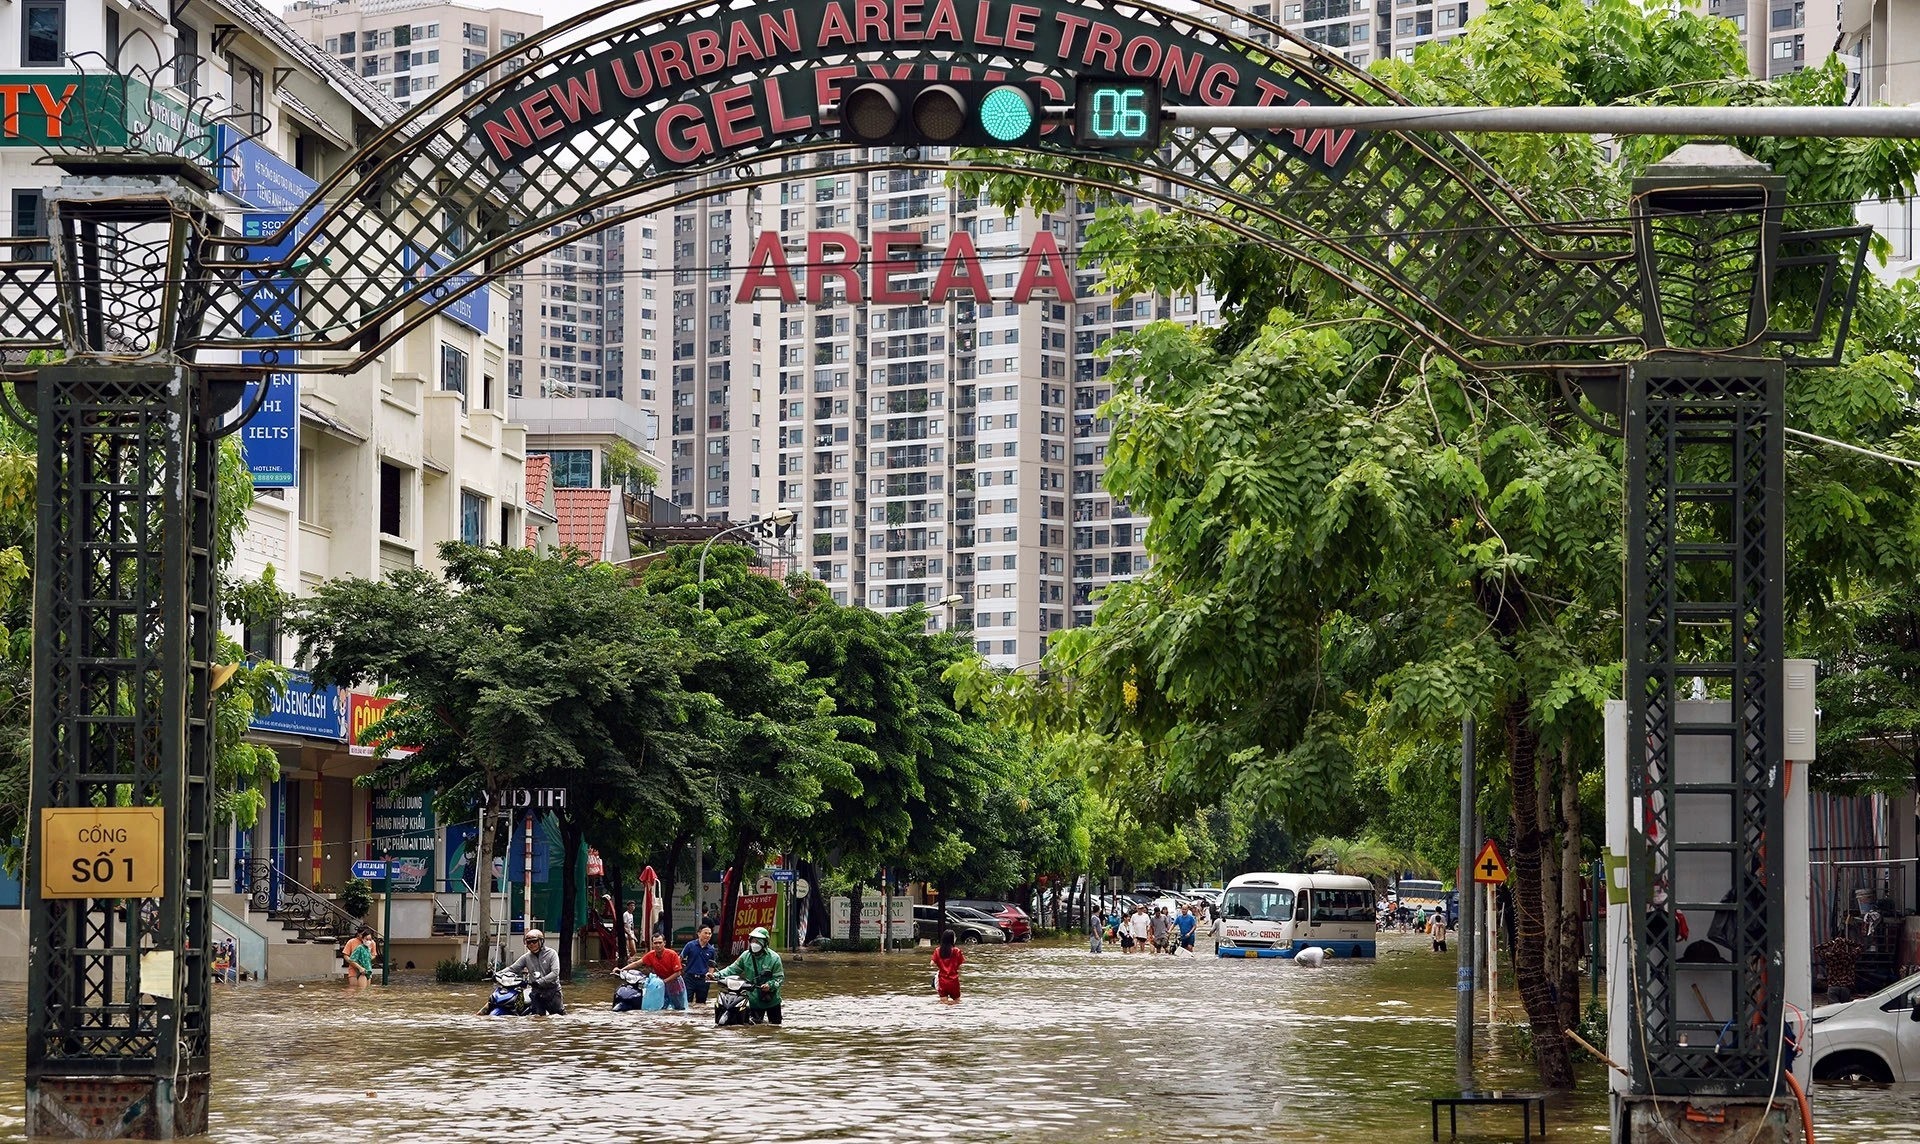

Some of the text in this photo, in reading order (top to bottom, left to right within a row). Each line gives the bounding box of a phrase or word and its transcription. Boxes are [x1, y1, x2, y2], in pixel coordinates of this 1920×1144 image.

[483, 0, 1357, 168] NEW URBAN AREA LE TRONG TAN
[1093, 89, 1147, 136] 06
[262, 220, 286, 230] SCO
[735, 230, 1077, 305] AREA A
[253, 287, 284, 300] AN
[249, 427, 289, 439] IELTS
[264, 687, 326, 719] COTSENGLISH
[354, 699, 385, 738] CÔN
[78, 823, 127, 843] CỔNG
[419, 835, 435, 851] TOÀN
[72, 848, 133, 883] SỐ 1
[736, 904, 774, 926] SỬA XE
